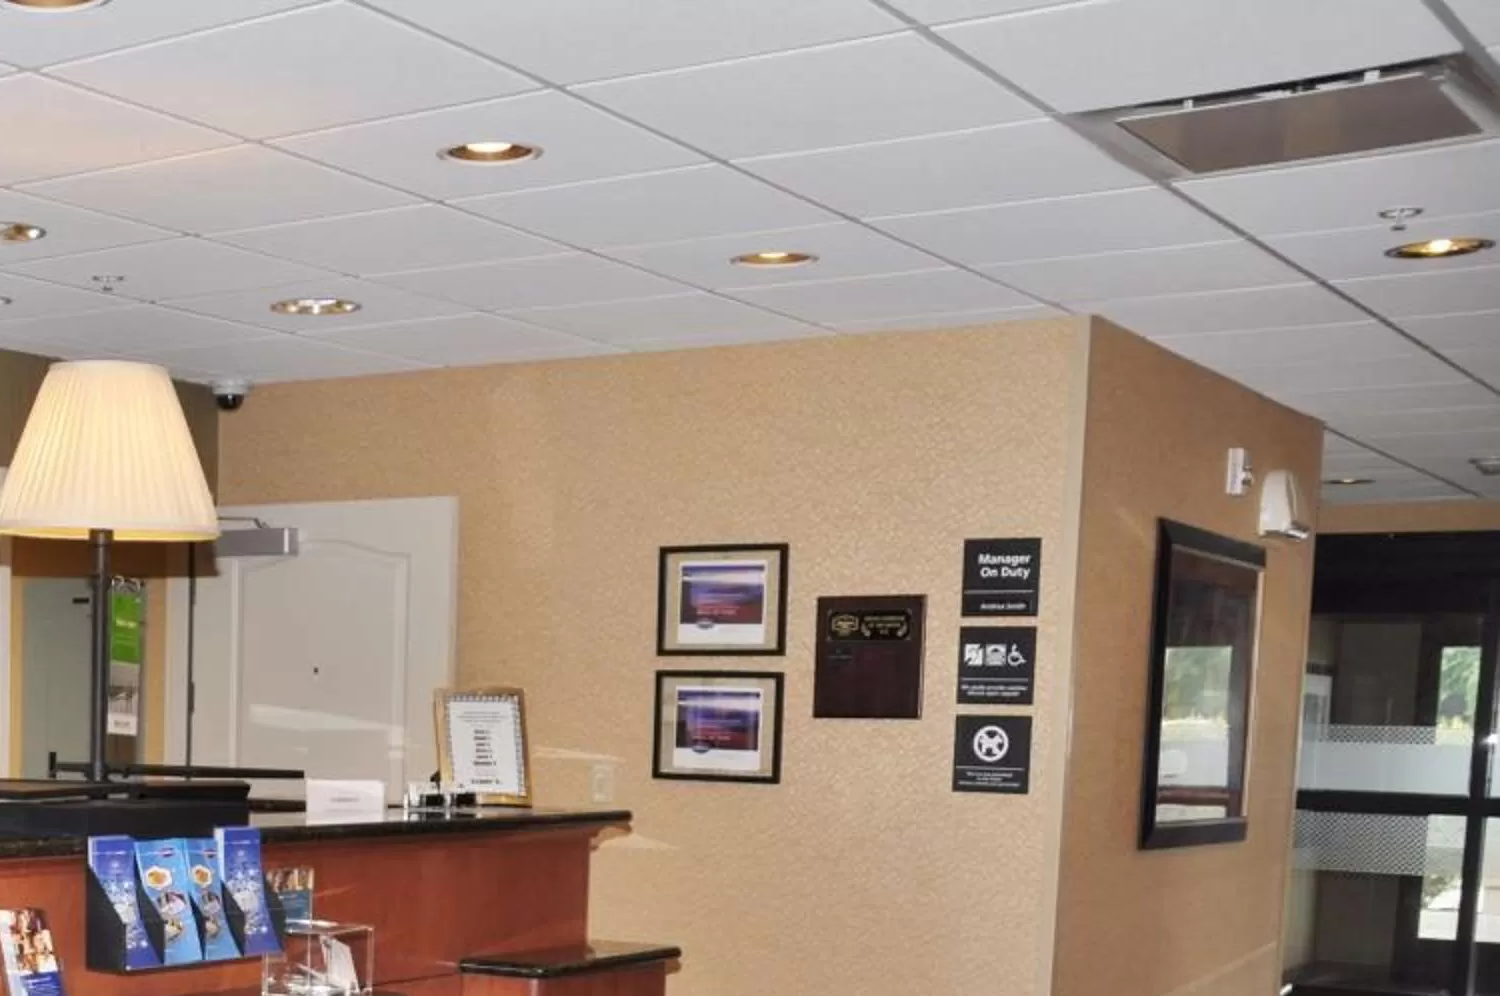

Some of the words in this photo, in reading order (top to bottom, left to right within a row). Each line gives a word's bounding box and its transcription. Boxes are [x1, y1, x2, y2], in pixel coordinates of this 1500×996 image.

[977, 553, 1032, 567] Manager
[979, 566, 999, 578] On
[1001, 566, 1031, 580] Duty
